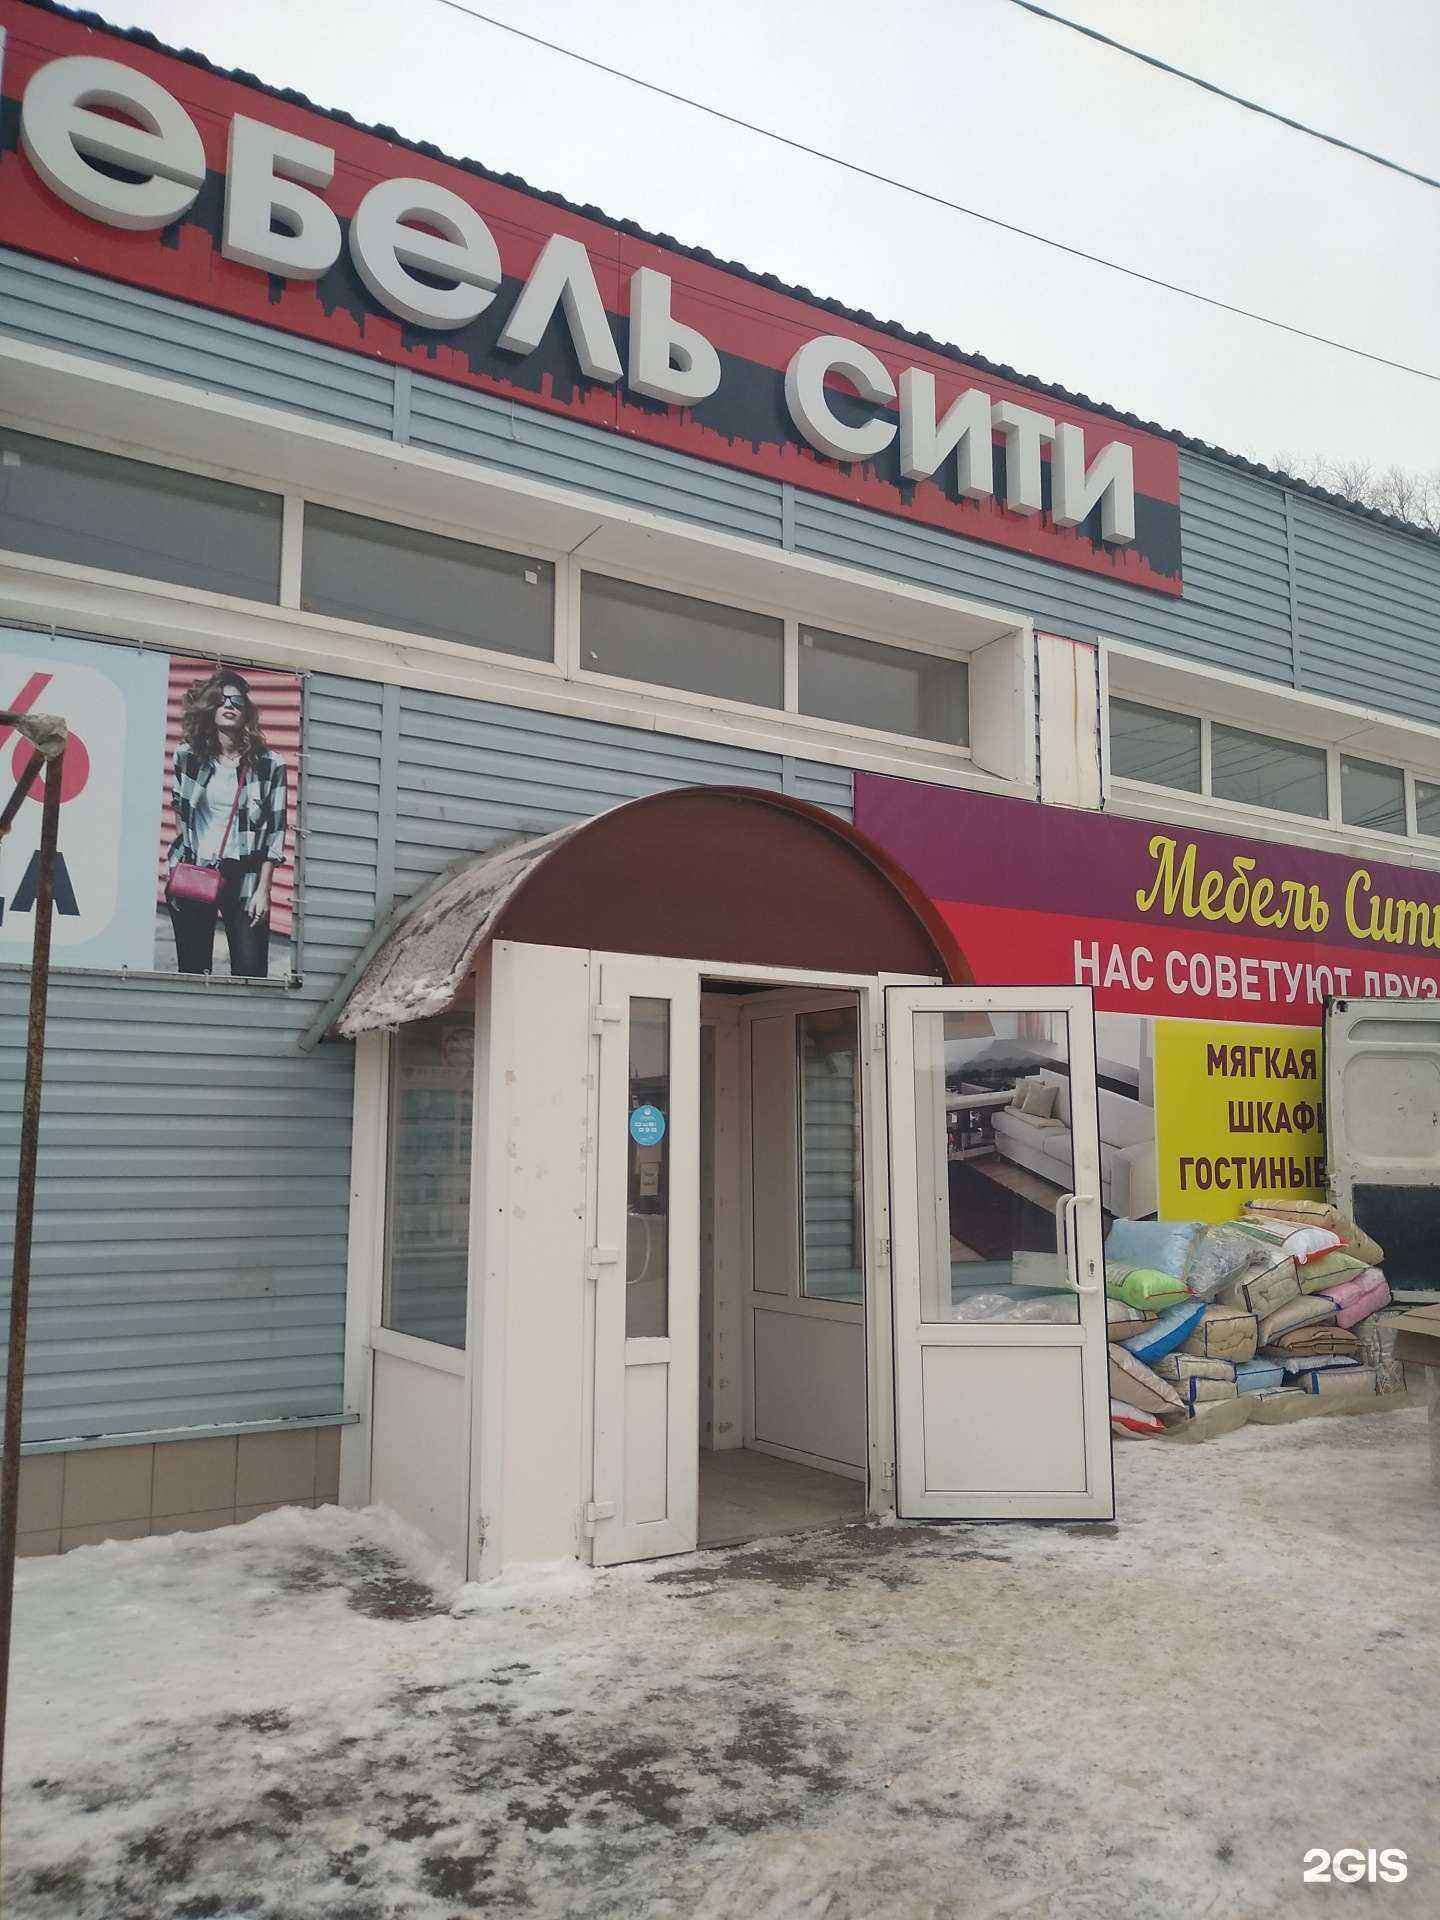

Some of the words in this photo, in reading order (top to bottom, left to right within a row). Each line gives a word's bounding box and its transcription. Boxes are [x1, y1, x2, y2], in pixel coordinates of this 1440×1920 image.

[1136, 835, 1330, 933] Мебель
[1073, 940, 1154, 991] НАС
[1165, 950, 1352, 1004] СОВЕТУЮТ
[1207, 1043, 1317, 1080] МЯГКАЯ
[1179, 1157, 1328, 1191] ГОСТИНЫЕ
